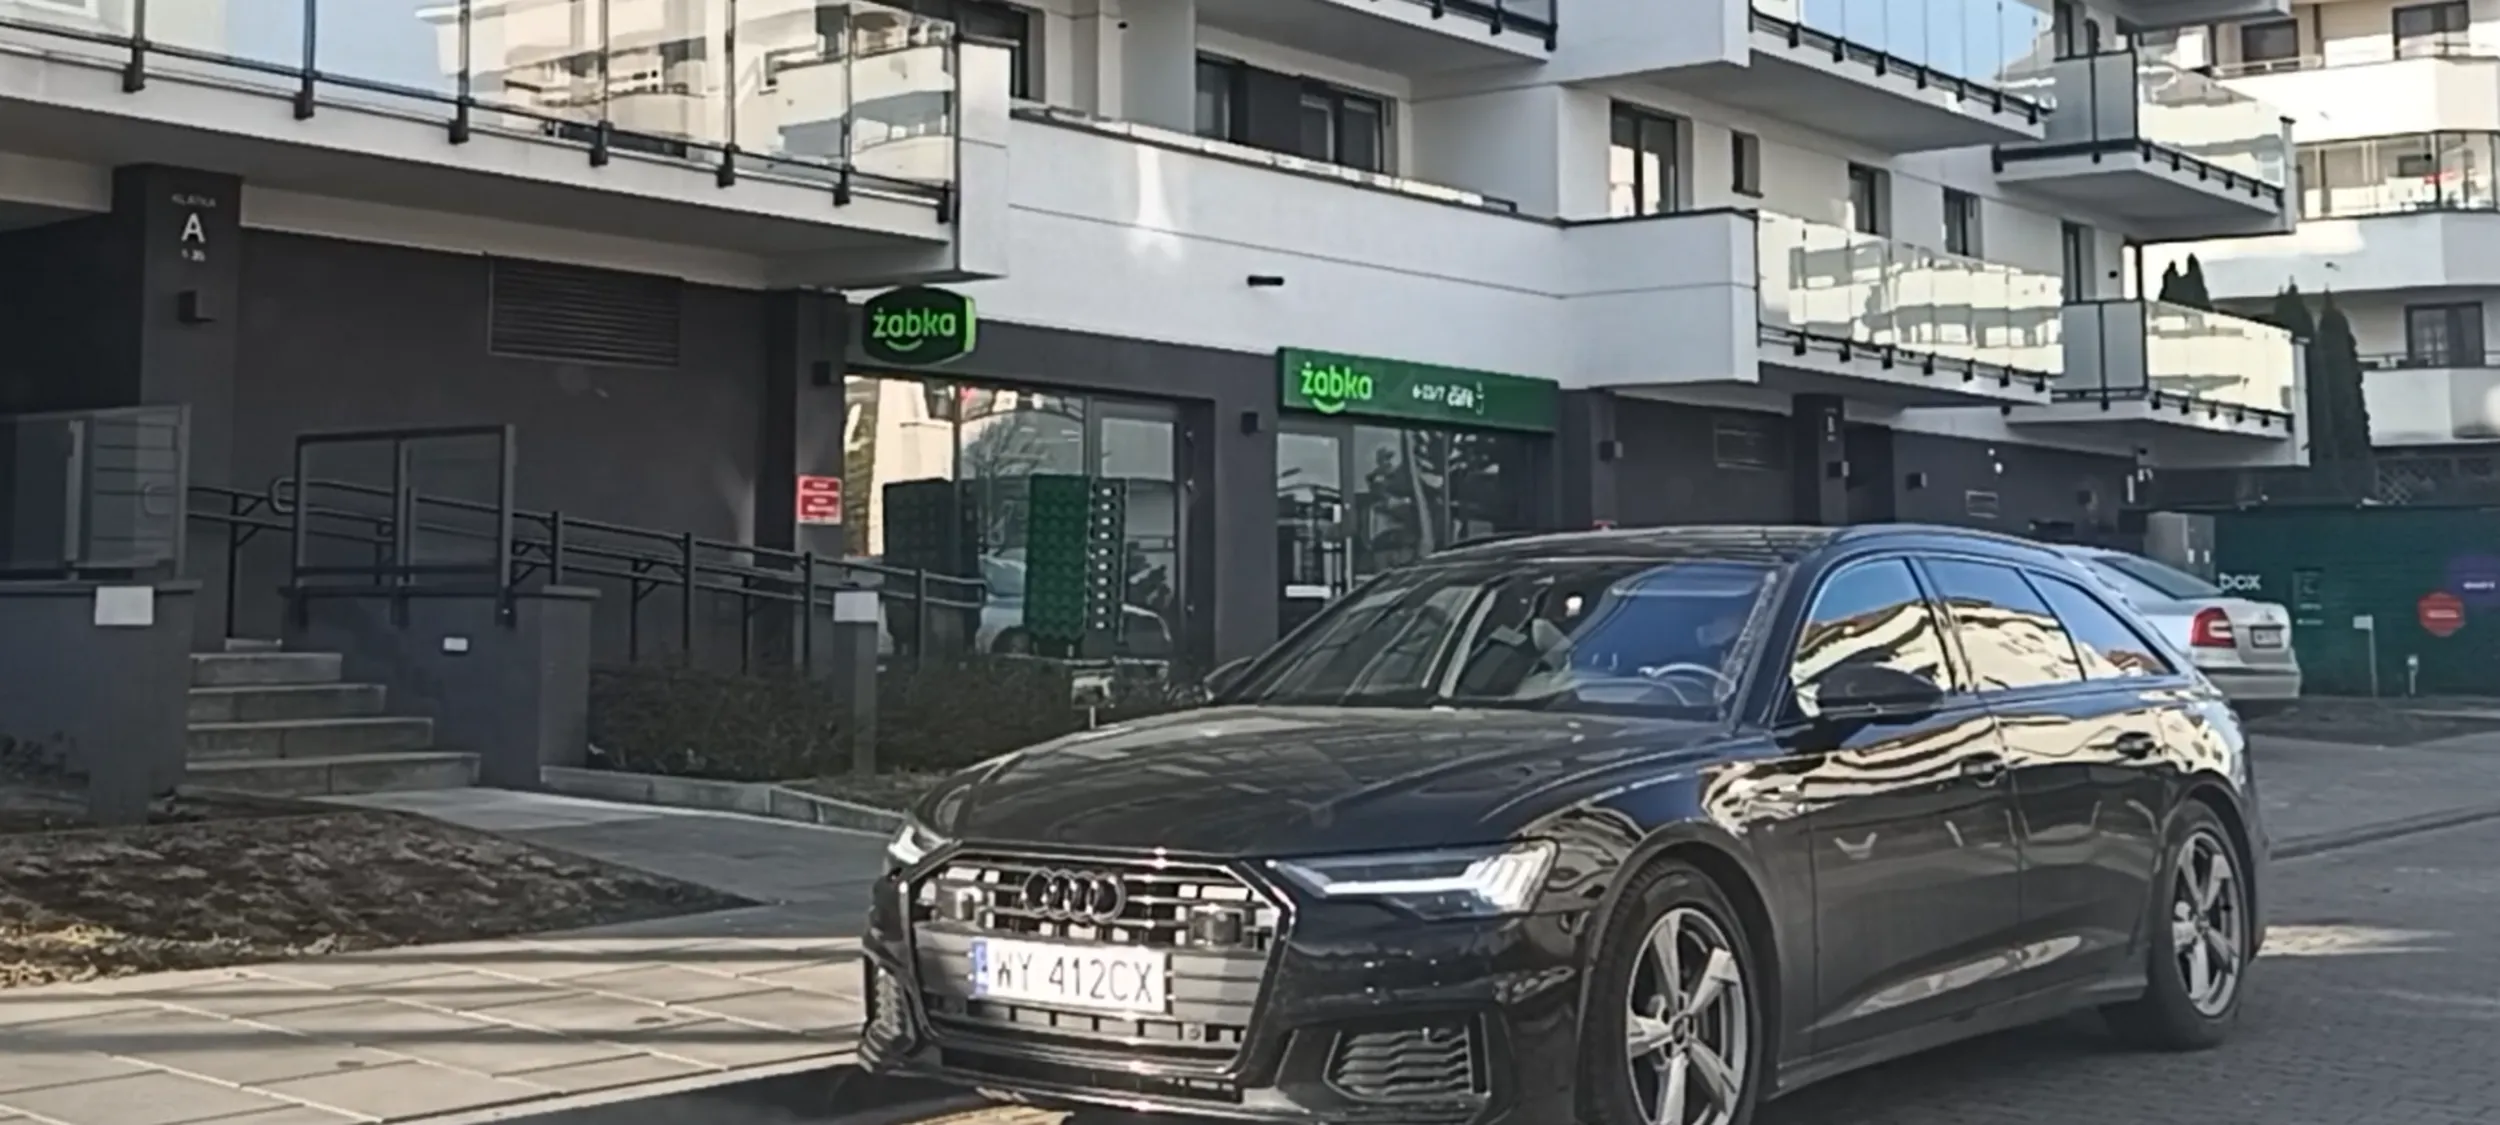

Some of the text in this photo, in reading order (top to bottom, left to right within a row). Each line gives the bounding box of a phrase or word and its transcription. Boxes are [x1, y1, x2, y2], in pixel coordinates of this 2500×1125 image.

[181, 212, 206, 244] A
[872, 307, 957, 338] żabka
[1301, 361, 1373, 400] żabka
[2218, 572, 2261, 590] box
[995, 950, 1153, 1004] WY 412CX
